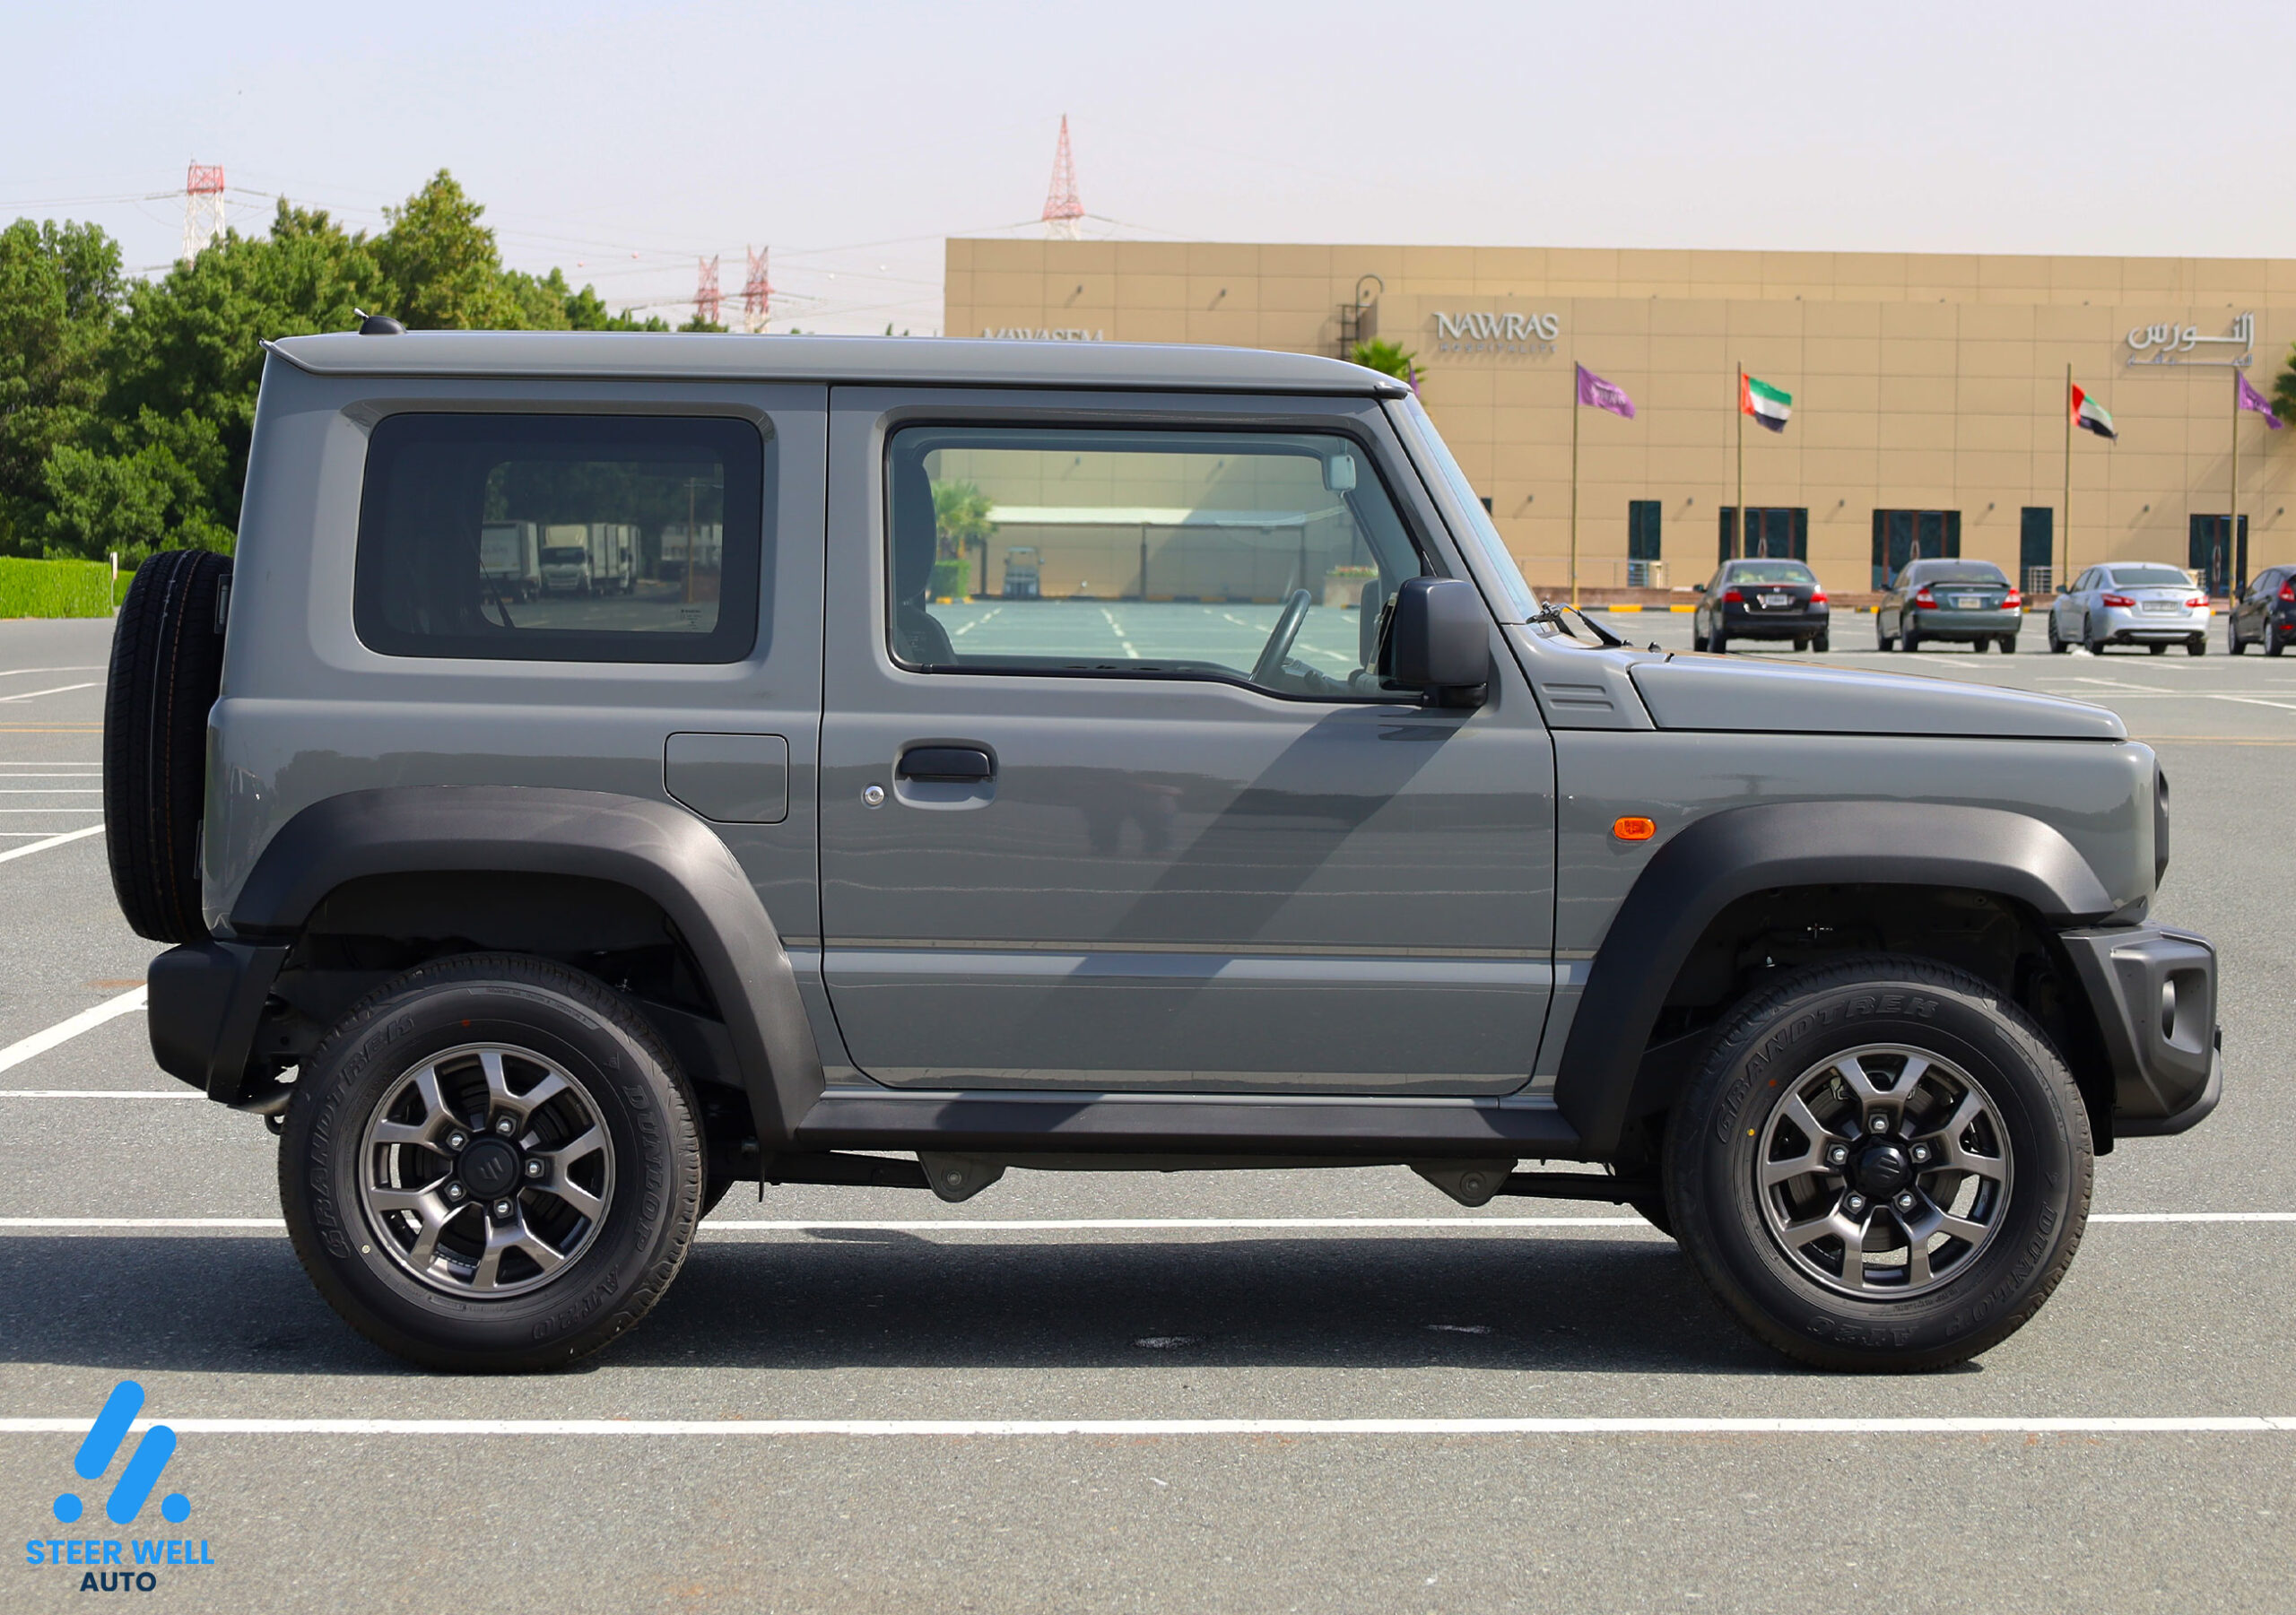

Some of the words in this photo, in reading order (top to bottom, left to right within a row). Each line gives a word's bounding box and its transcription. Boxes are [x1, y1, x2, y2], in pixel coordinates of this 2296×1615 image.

[1431, 311, 1559, 341] NAWRAS
[2127, 312, 2255, 352] النورس
[309, 1012, 416, 1260] GRANDTREK
[1714, 994, 1941, 1147] GRANDTREK
[621, 1083, 665, 1254] DUNLOP
[1944, 1199, 2058, 1341] DUNLOP
